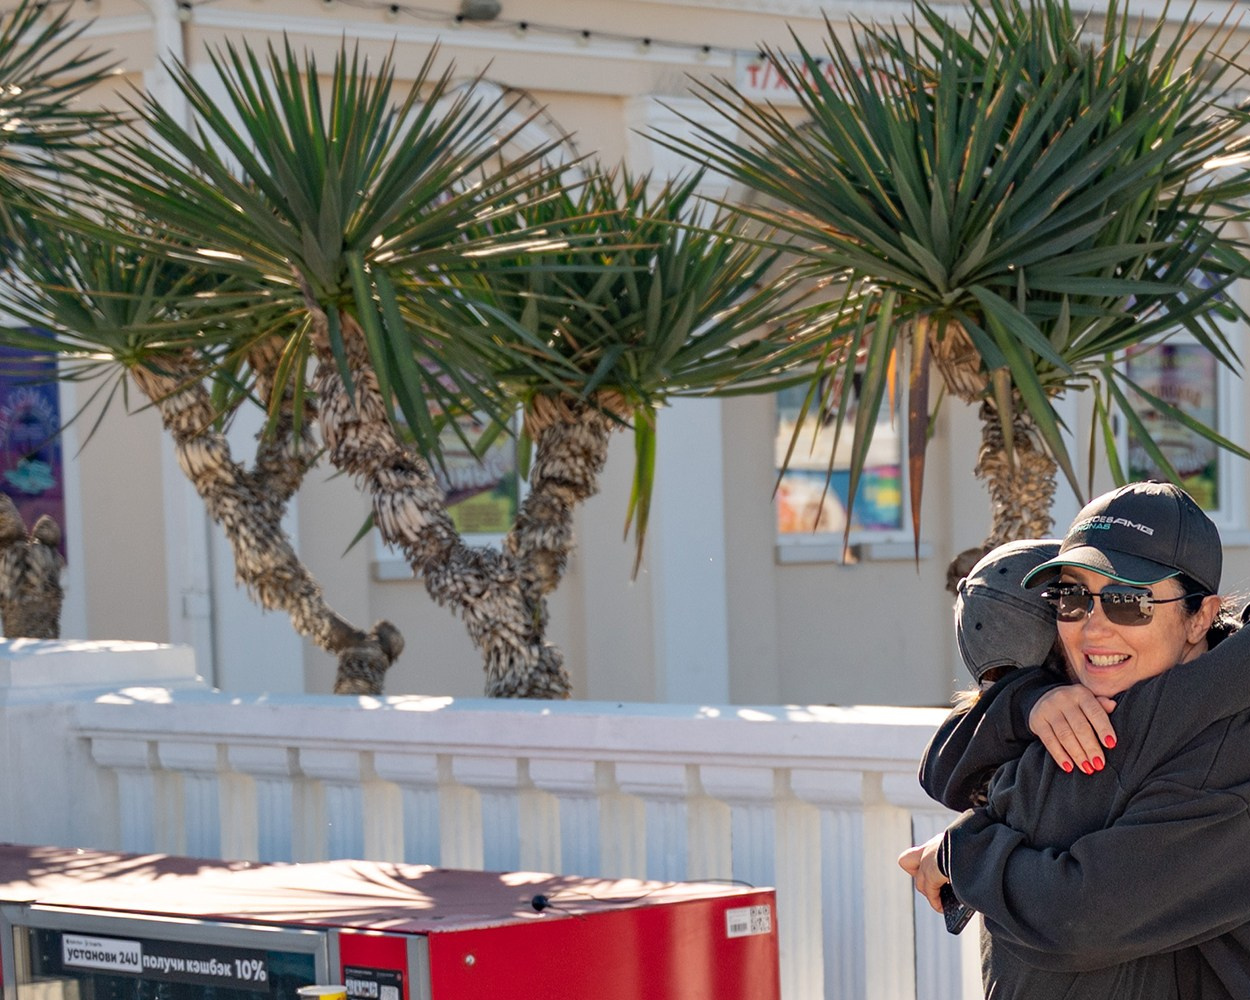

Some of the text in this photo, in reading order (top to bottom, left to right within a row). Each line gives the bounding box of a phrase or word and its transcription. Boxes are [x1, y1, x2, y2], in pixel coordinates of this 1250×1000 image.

[67, 948, 267, 981] установи 24U получи кэшбэк 10%
